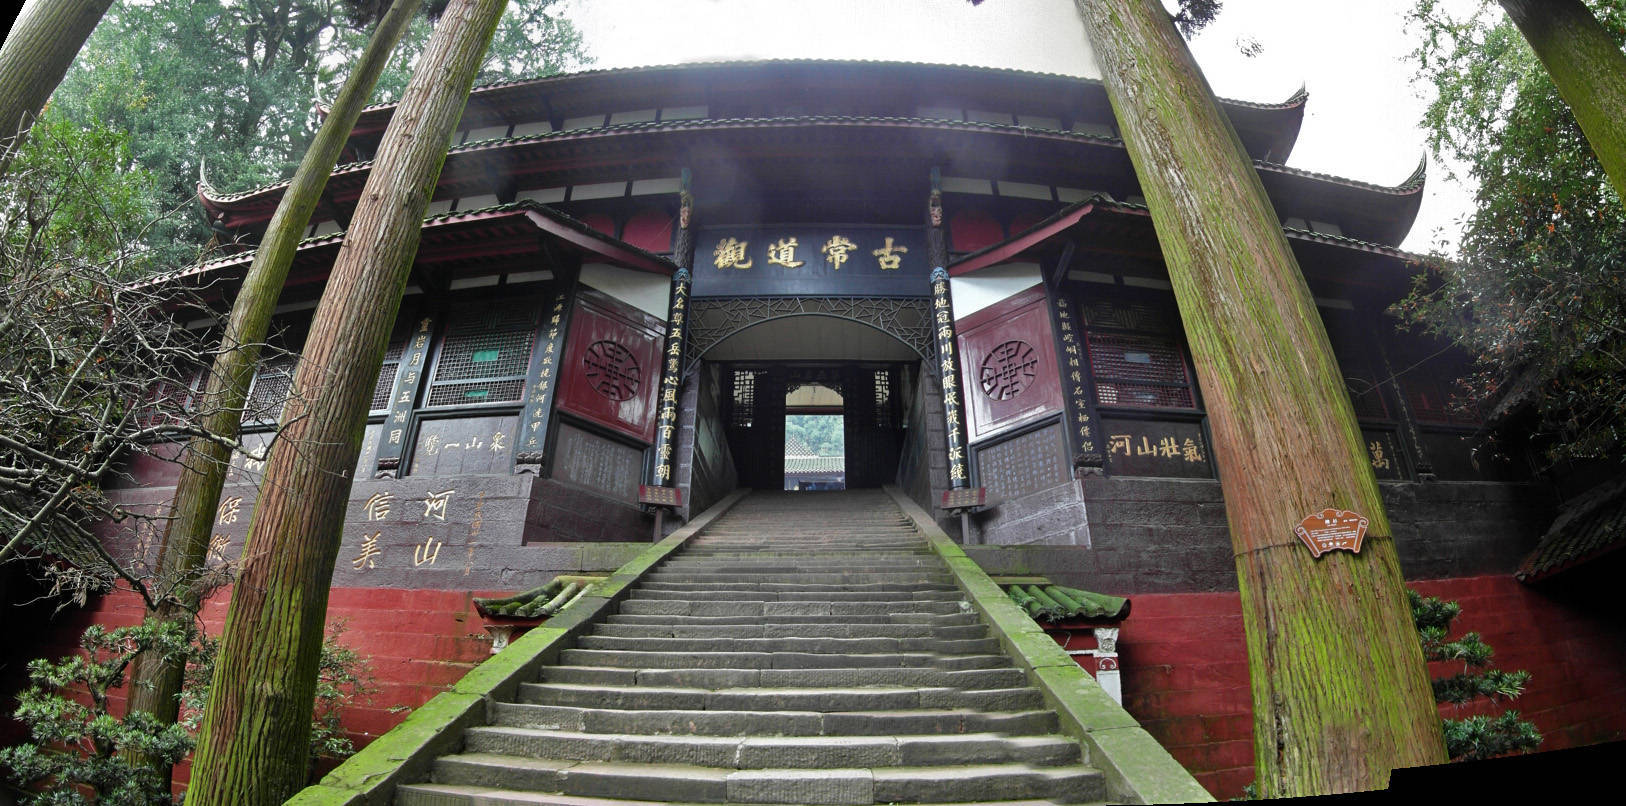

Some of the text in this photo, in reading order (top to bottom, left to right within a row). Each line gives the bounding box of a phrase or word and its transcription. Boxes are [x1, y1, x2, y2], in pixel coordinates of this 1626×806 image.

[713, 235, 908, 270] 古常道觀
[1109, 434, 1202, 463] 氣壯山河
